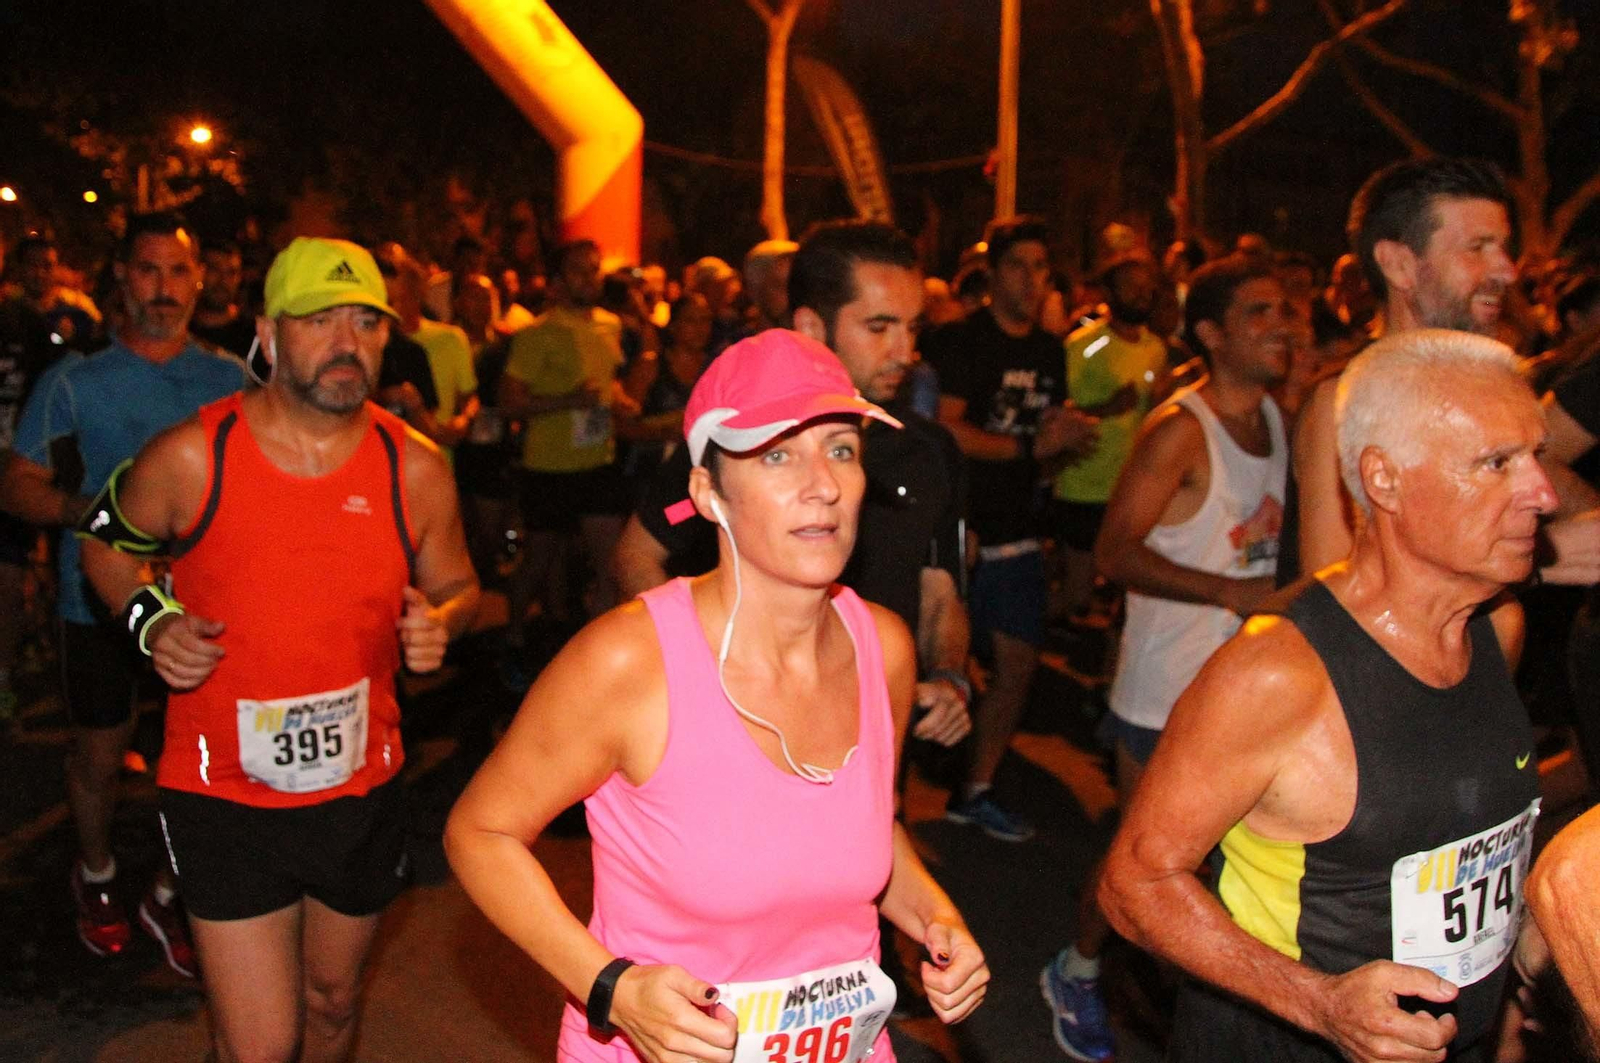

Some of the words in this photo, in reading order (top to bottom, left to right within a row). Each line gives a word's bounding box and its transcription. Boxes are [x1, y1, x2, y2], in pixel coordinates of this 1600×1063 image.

[273, 725, 342, 765] 395
[1458, 813, 1531, 865] NOCTURN
[1455, 860, 1479, 886] DE
[1443, 865, 1513, 943] 574
[736, 990, 783, 1033] VII
[783, 970, 868, 1009] NOCTURNA
[778, 1008, 806, 1032] DE
[811, 987, 876, 1025] HUELVA
[763, 1015, 854, 1063] 396
